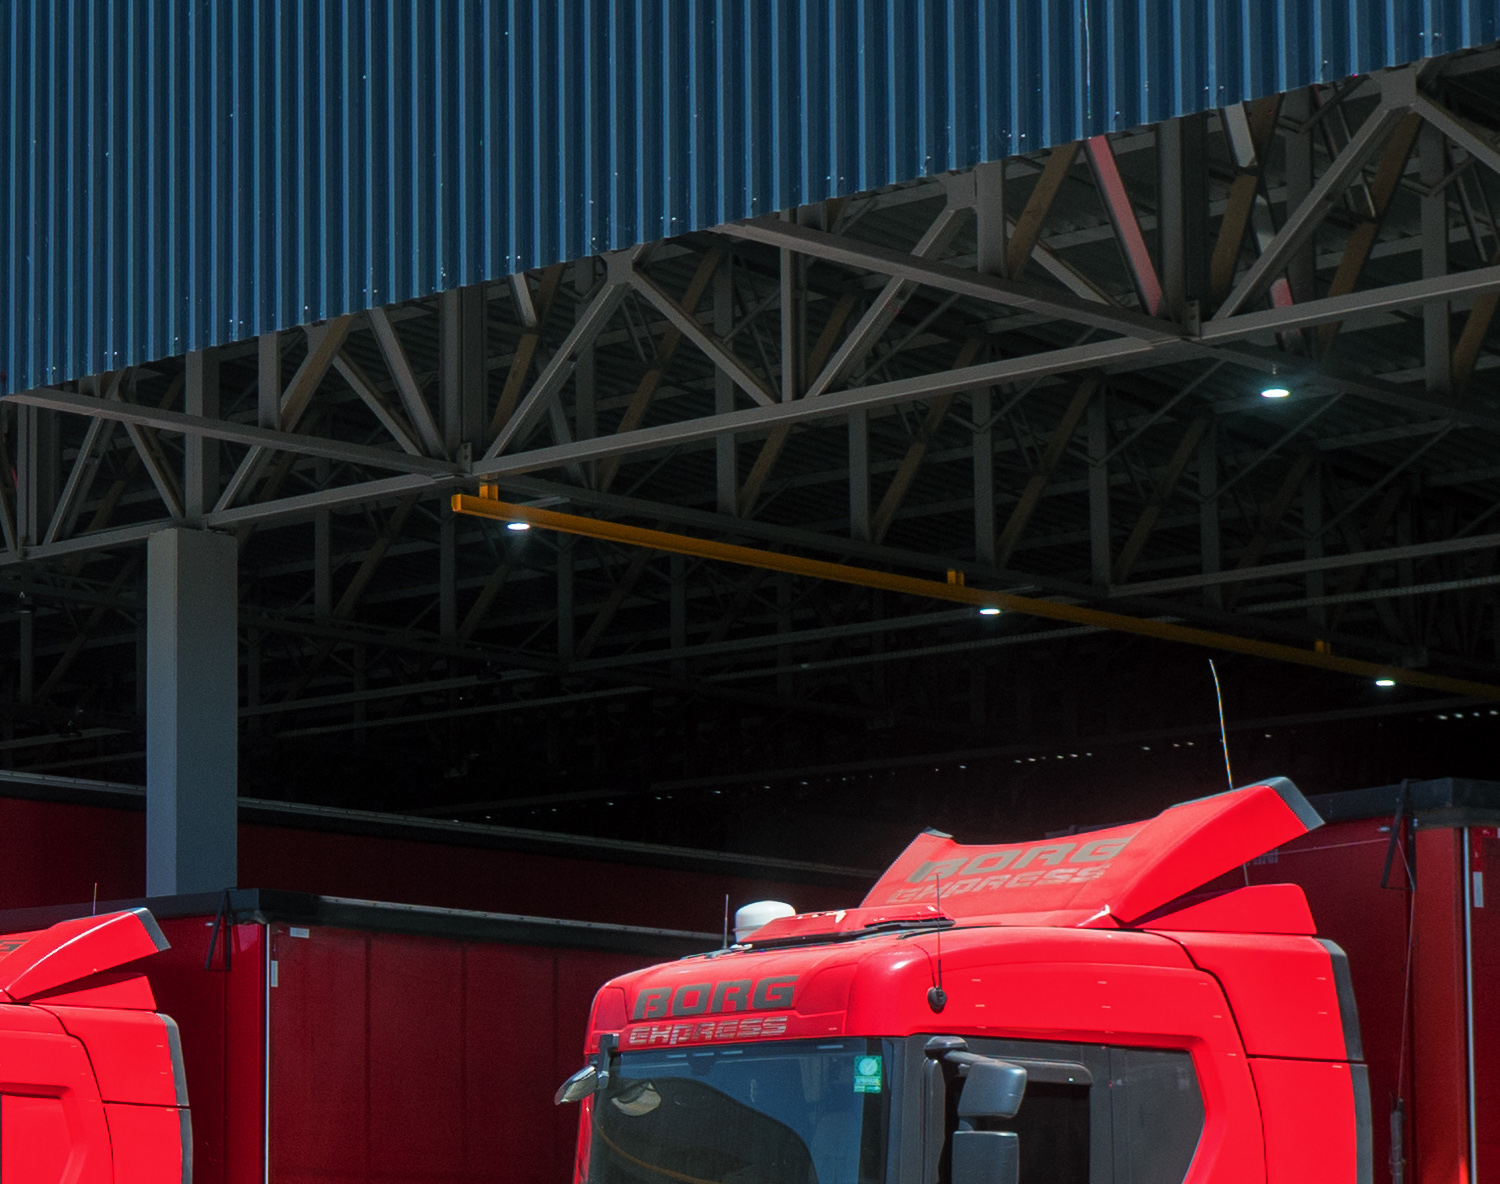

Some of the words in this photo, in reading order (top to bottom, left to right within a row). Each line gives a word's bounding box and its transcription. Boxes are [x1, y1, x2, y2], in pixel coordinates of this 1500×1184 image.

[906, 835, 1135, 884] BORG
[632, 975, 799, 1021] BORG
[629, 1015, 788, 1045] EXPRESS
